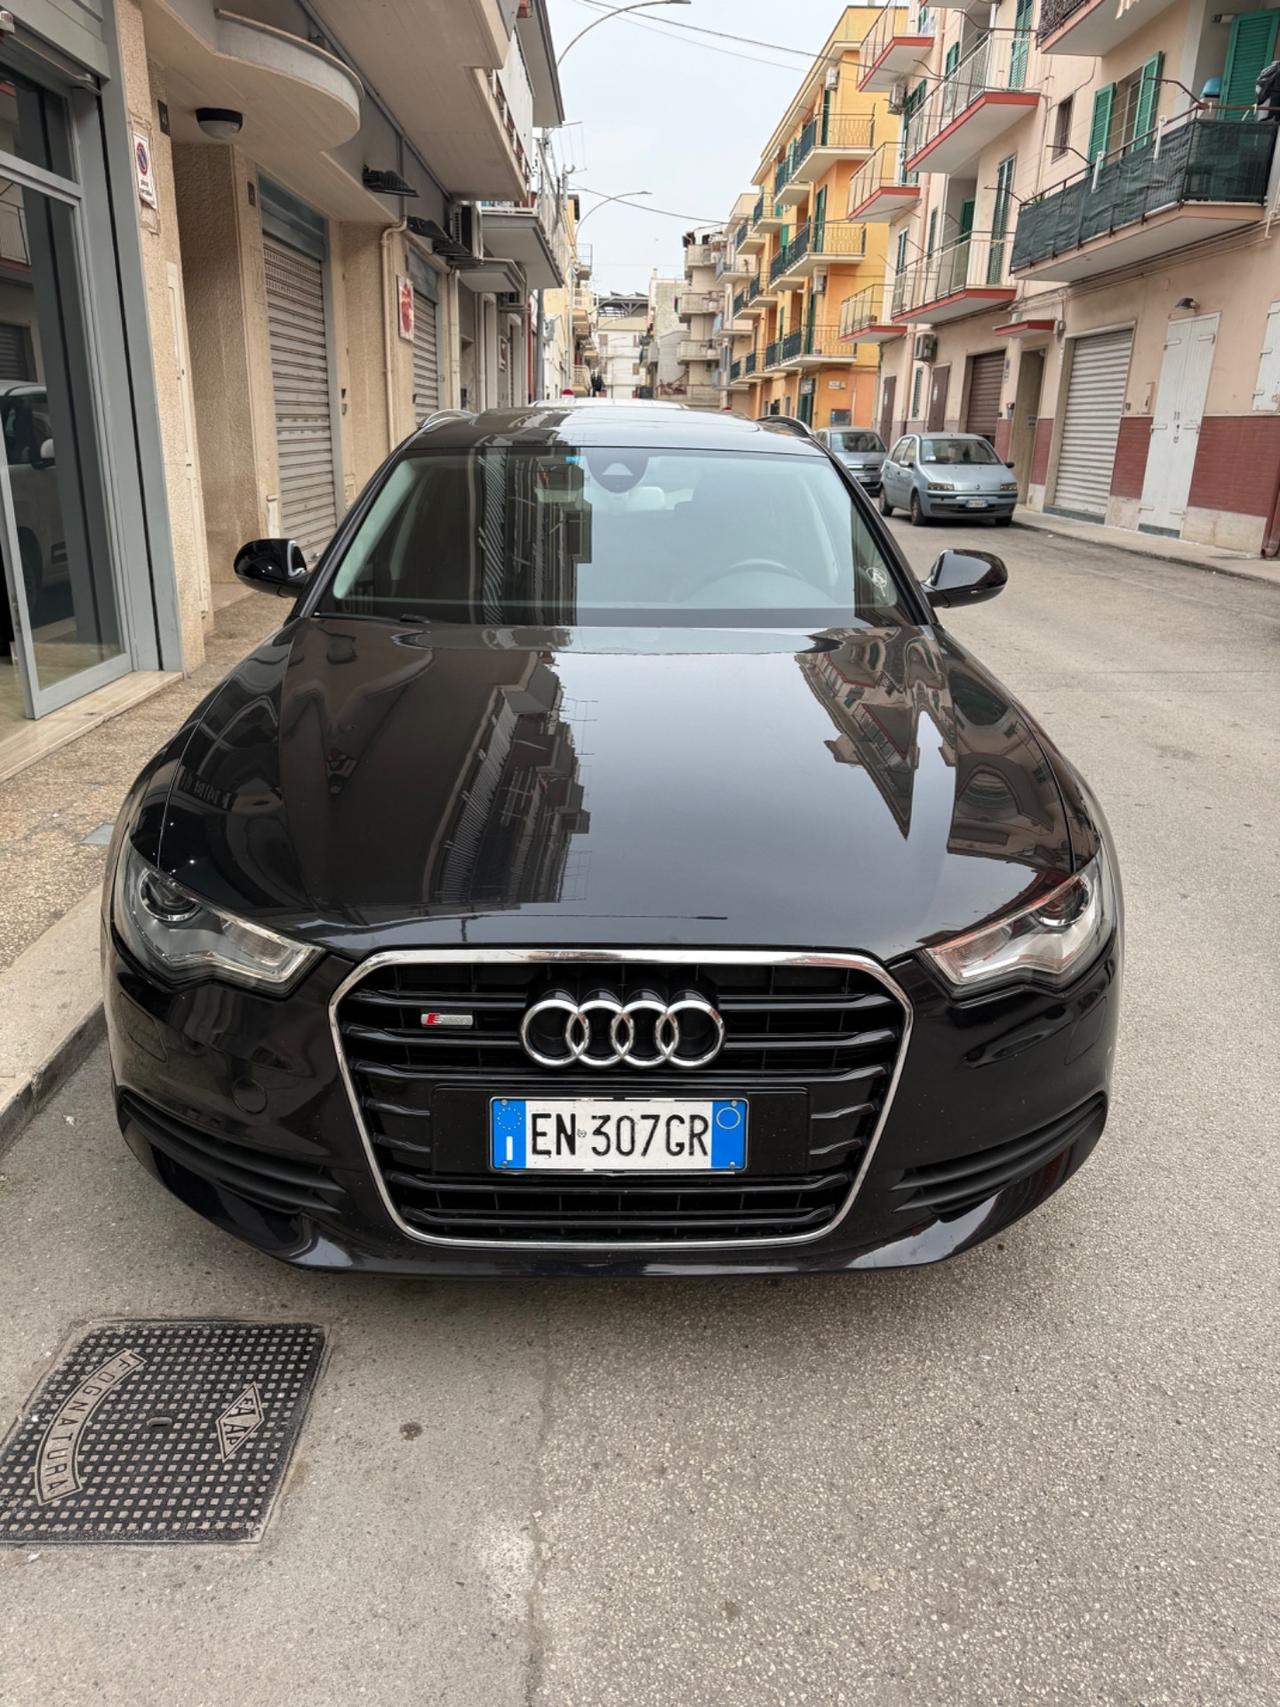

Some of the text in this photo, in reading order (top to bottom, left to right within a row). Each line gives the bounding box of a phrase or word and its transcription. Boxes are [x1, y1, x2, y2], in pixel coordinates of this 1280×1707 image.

[531, 1113, 576, 1157] EN
[591, 1113, 709, 1157] 307GR
[45, 1358, 131, 1492] FOGNATURA
